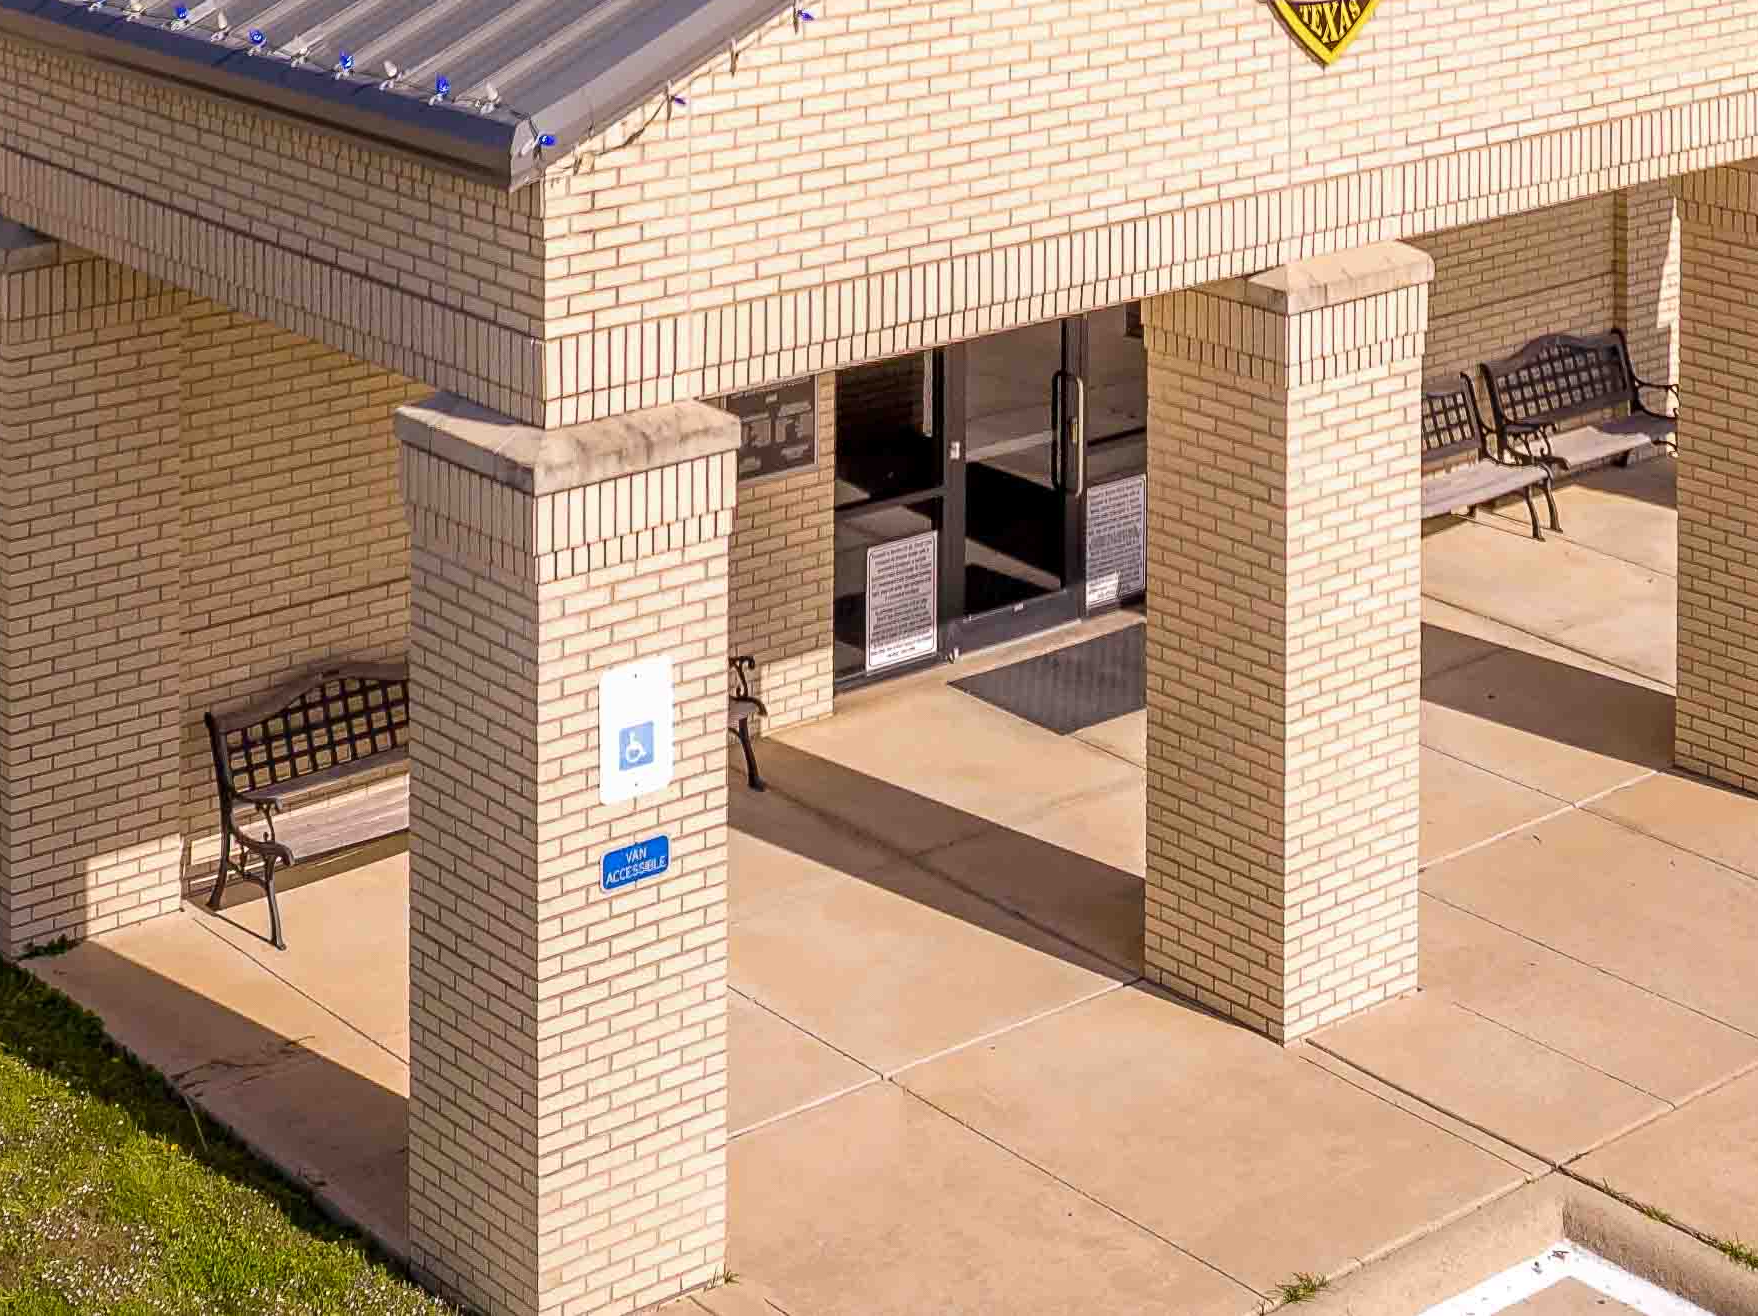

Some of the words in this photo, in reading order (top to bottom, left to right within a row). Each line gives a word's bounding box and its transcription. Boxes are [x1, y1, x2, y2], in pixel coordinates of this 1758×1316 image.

[1299, 0, 1361, 44] TEXAS
[606, 855, 667, 886] ACCESSIBLE
[626, 847, 647, 863] VAN
